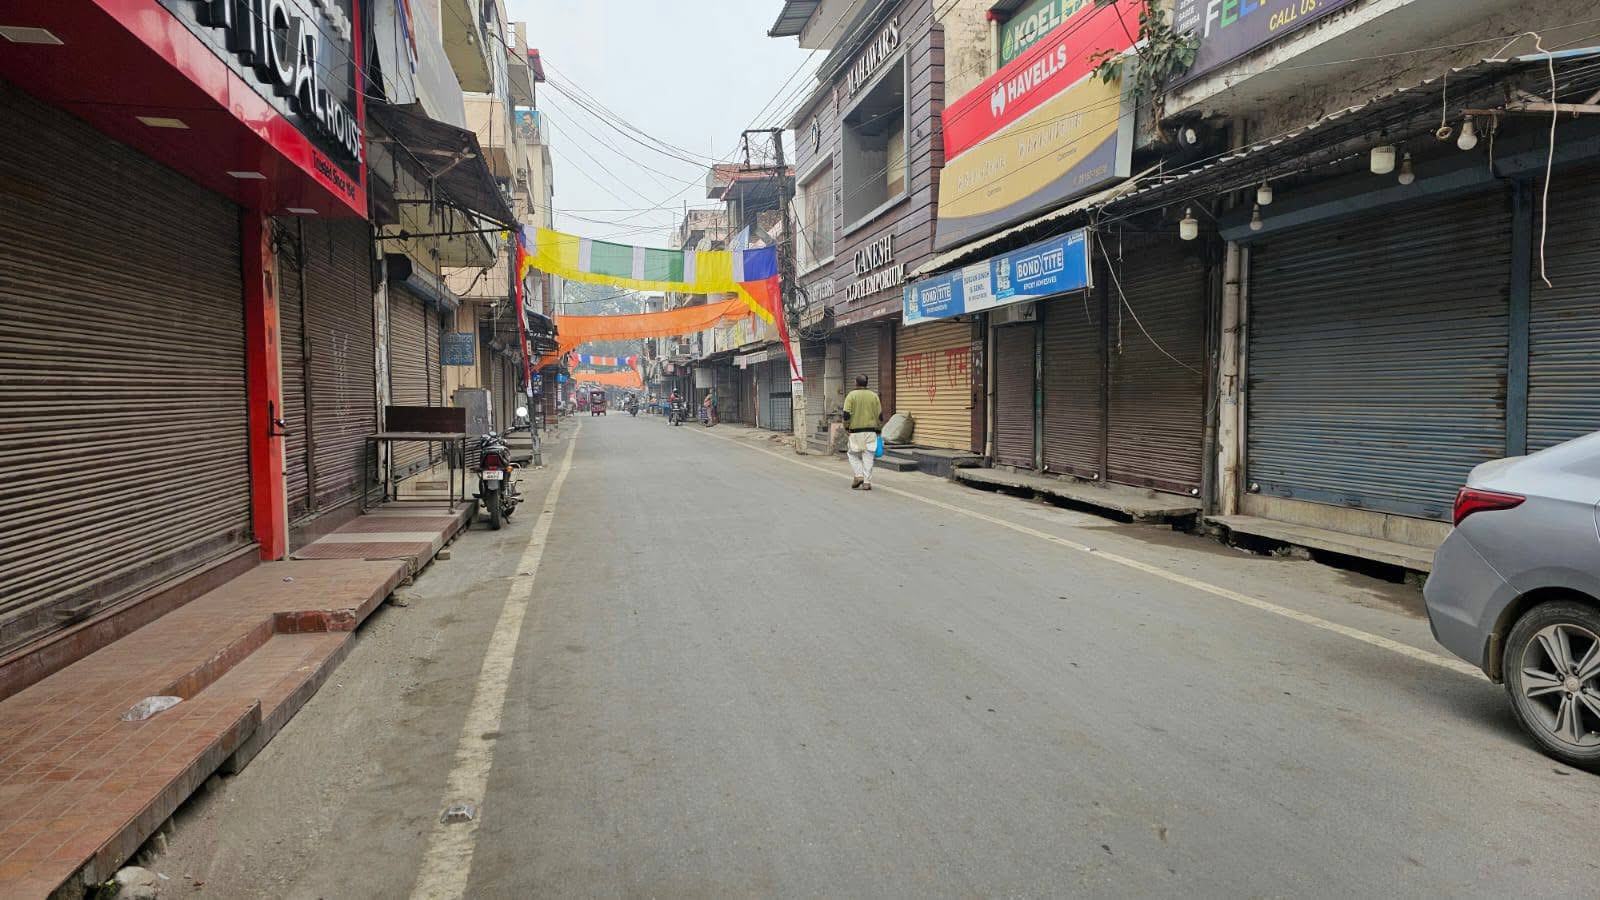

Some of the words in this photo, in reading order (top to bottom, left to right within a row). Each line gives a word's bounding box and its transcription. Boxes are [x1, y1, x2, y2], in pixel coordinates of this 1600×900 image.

[1014, 1, 1061, 52] KOEL
[1269, 3, 1298, 32] CALL
[847, 16, 899, 98] MAHAWAR'S
[1007, 44, 1067, 103] HAVELLS
[325, 93, 363, 164] HOUSE
[854, 234, 893, 276] GANESH
[845, 277, 866, 303] CLOTH
